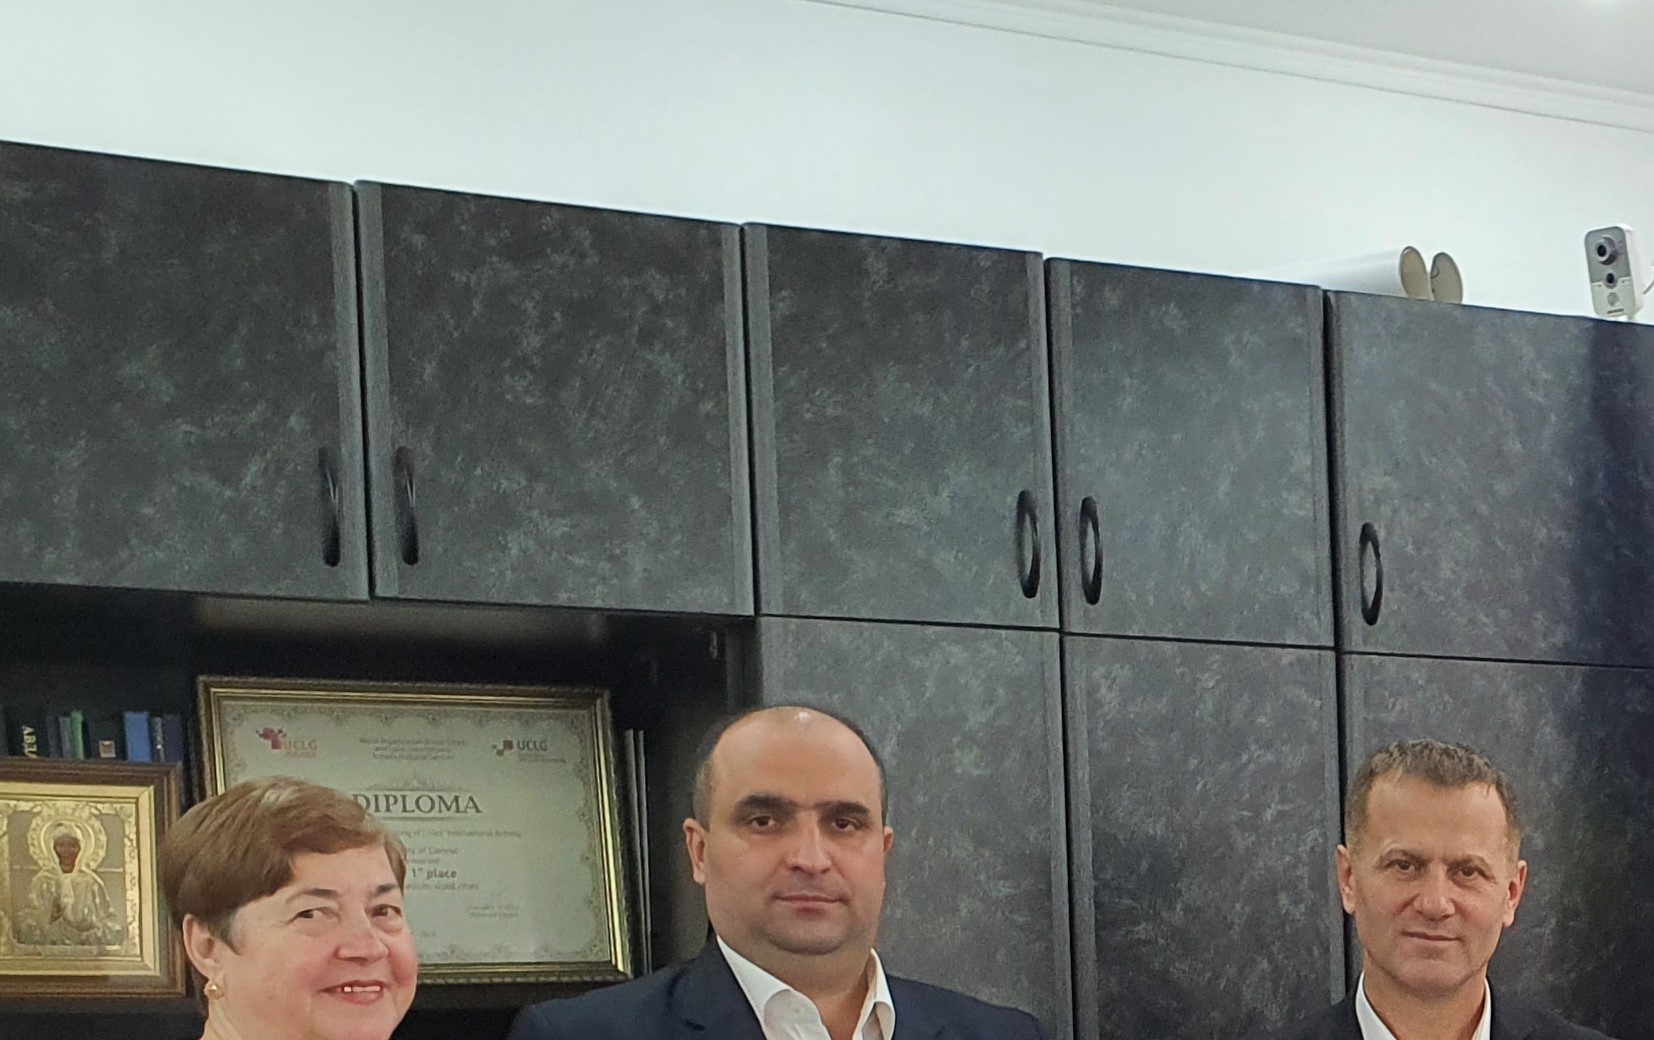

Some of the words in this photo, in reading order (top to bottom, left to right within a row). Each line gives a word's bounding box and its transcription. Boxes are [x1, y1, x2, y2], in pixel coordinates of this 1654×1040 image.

[516, 739, 548, 752] UCLG
[352, 793, 483, 814] DIPLOMA
[426, 868, 457, 880] place
